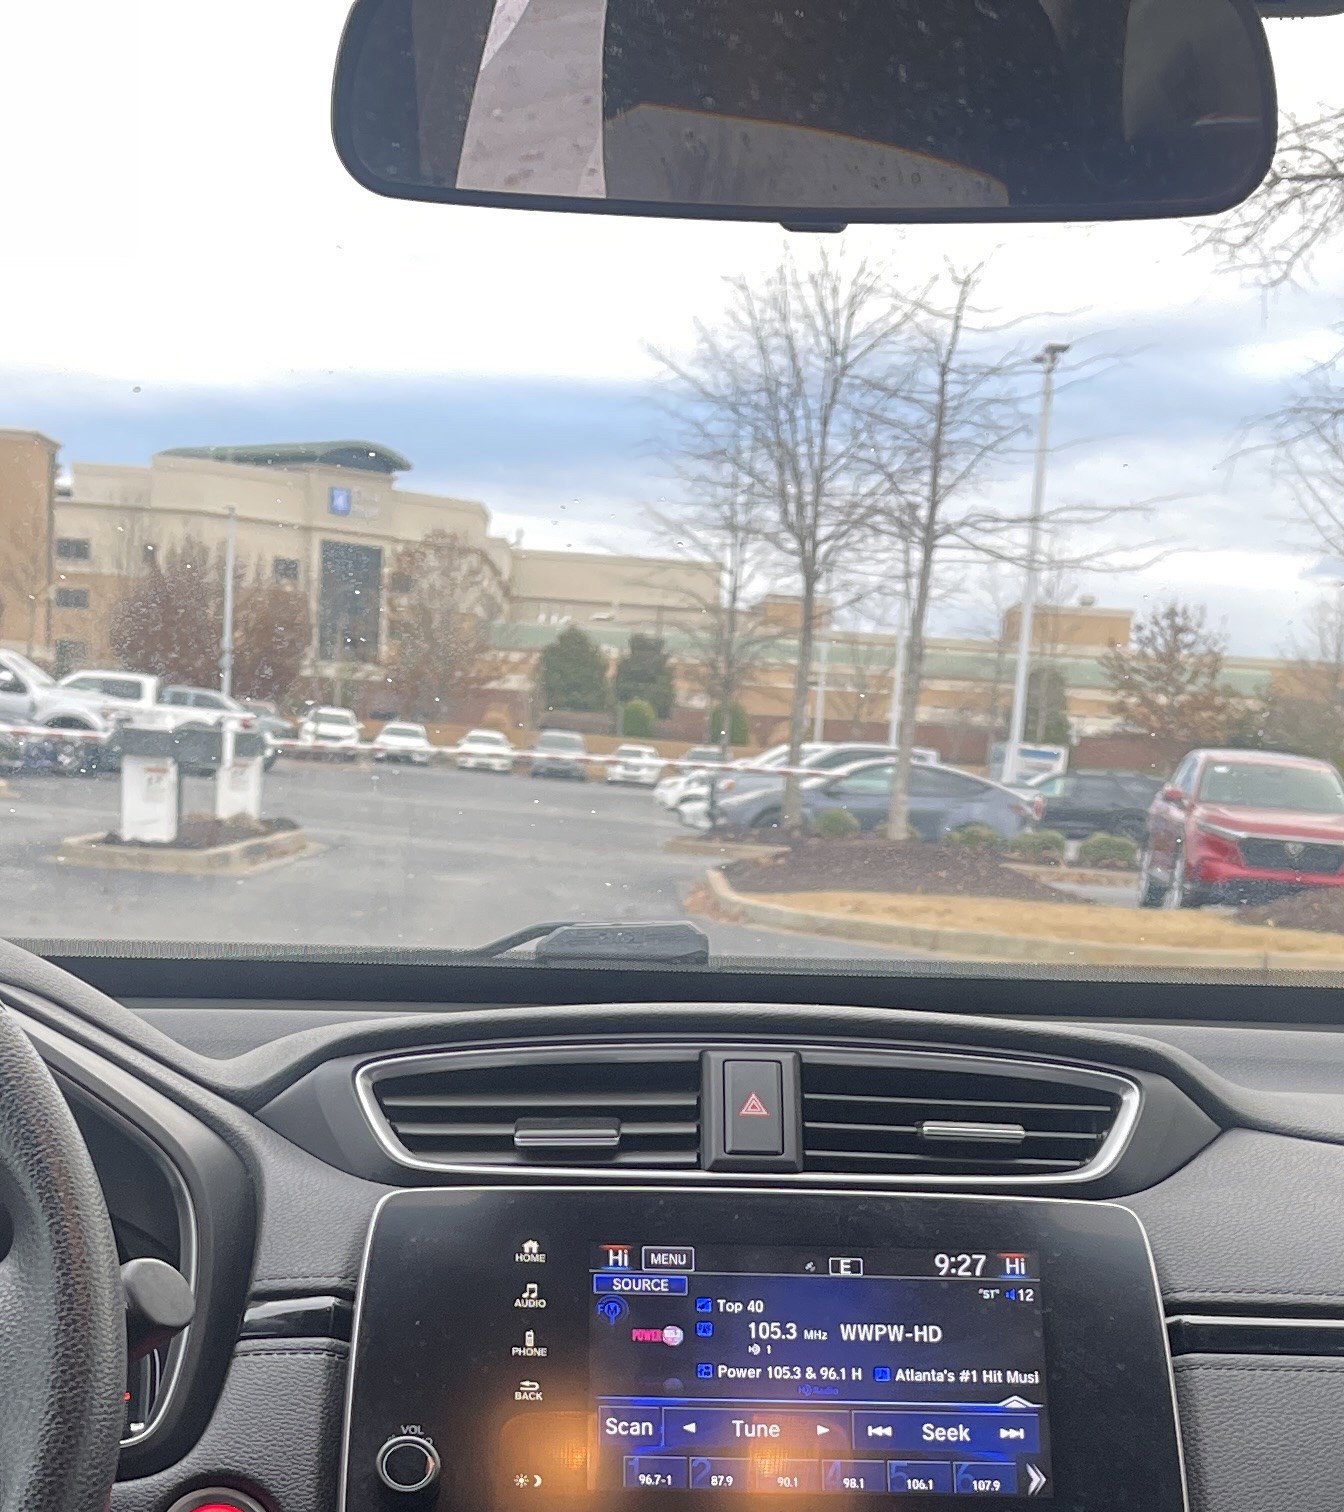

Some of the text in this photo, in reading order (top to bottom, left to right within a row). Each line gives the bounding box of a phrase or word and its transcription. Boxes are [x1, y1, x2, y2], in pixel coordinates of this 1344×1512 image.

[515, 1253, 546, 1263] HOME
[608, 1249, 630, 1268] Hi
[650, 1252, 687, 1266] MENU
[934, 1253, 987, 1277] 9:27
[840, 1259, 852, 1275] E
[1005, 1257, 1027, 1275] Hi
[612, 1277, 669, 1292] SOURCE
[1018, 1288, 1034, 1302] 12
[514, 1298, 547, 1309] AUDIO
[717, 1299, 764, 1314] Top 40
[748, 1321, 943, 1343] 105.3 MHz WWPW-HD
[511, 1347, 548, 1357] PHONE
[717, 1364, 863, 1381] Power 105.3 & 96.1 H
[895, 1368, 1040, 1384] Atlanta's #1 Hit Musi
[514, 1391, 543, 1401] BACK
[400, 1424, 425, 1435] VOL
[605, 1417, 653, 1436] Scan
[732, 1419, 780, 1438] Tune
[922, 1422, 971, 1442] Seek
[638, 1473, 673, 1486] 96.7-1
[710, 1475, 734, 1487] 87.9
[777, 1476, 798, 1488] 90.1
[842, 1477, 865, 1490] 98.1
[906, 1479, 934, 1491] 106.1
[972, 1479, 1001, 1492] 107.9
